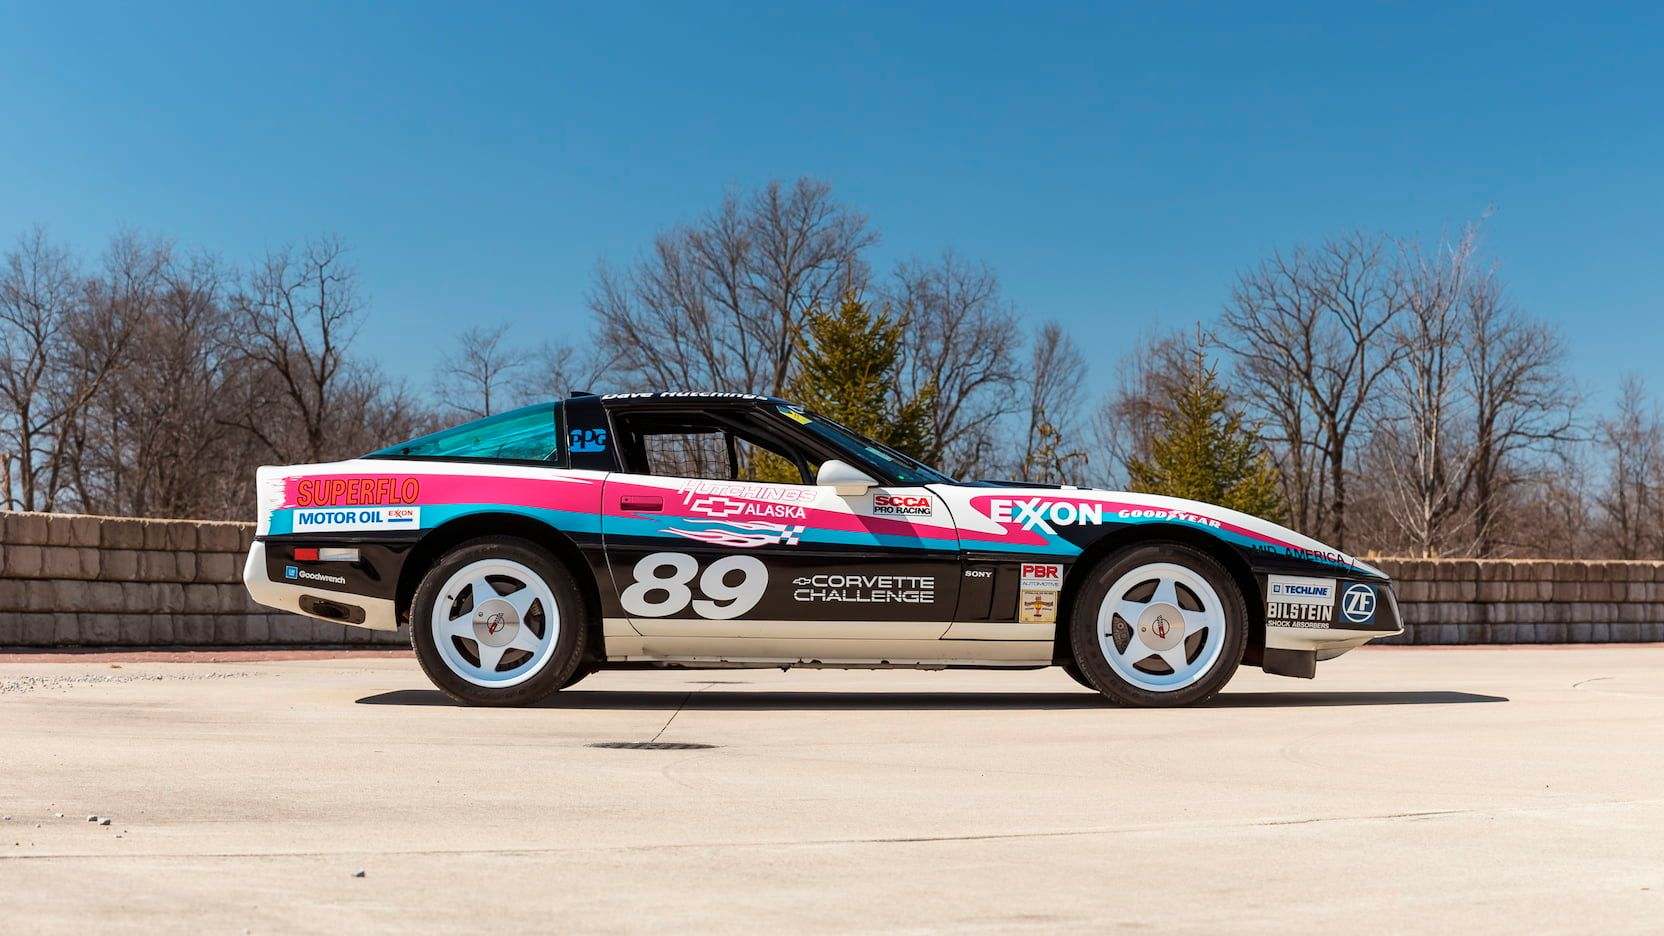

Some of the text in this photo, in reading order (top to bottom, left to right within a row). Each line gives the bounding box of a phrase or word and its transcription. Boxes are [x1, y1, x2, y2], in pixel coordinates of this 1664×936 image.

[297, 478, 420, 507] SUPERFLO
[875, 496, 930, 507] SCCA
[388, 510, 413, 518] EXXON
[744, 503, 806, 519] ALASKA
[874, 506, 931, 515] PRO RACING
[990, 497, 1103, 535] EXXON
[299, 511, 384, 525] MOTOR OIL
[1118, 509, 1221, 529] GOODYEAR
[1285, 547, 1345, 563] AMERICA
[299, 570, 346, 584] Goodwrench
[965, 570, 992, 578] SONY
[1022, 565, 1059, 578] PBR
[620, 552, 769, 620] 89
[812, 575, 935, 589] CORVETTE
[794, 589, 935, 604] CHALLENGE
[1285, 585, 1328, 596] TECHLINE
[1347, 591, 1375, 615] ZF
[1267, 602, 1333, 621] BILSTEIN
[1292, 621, 1330, 629] ABSORBERS
